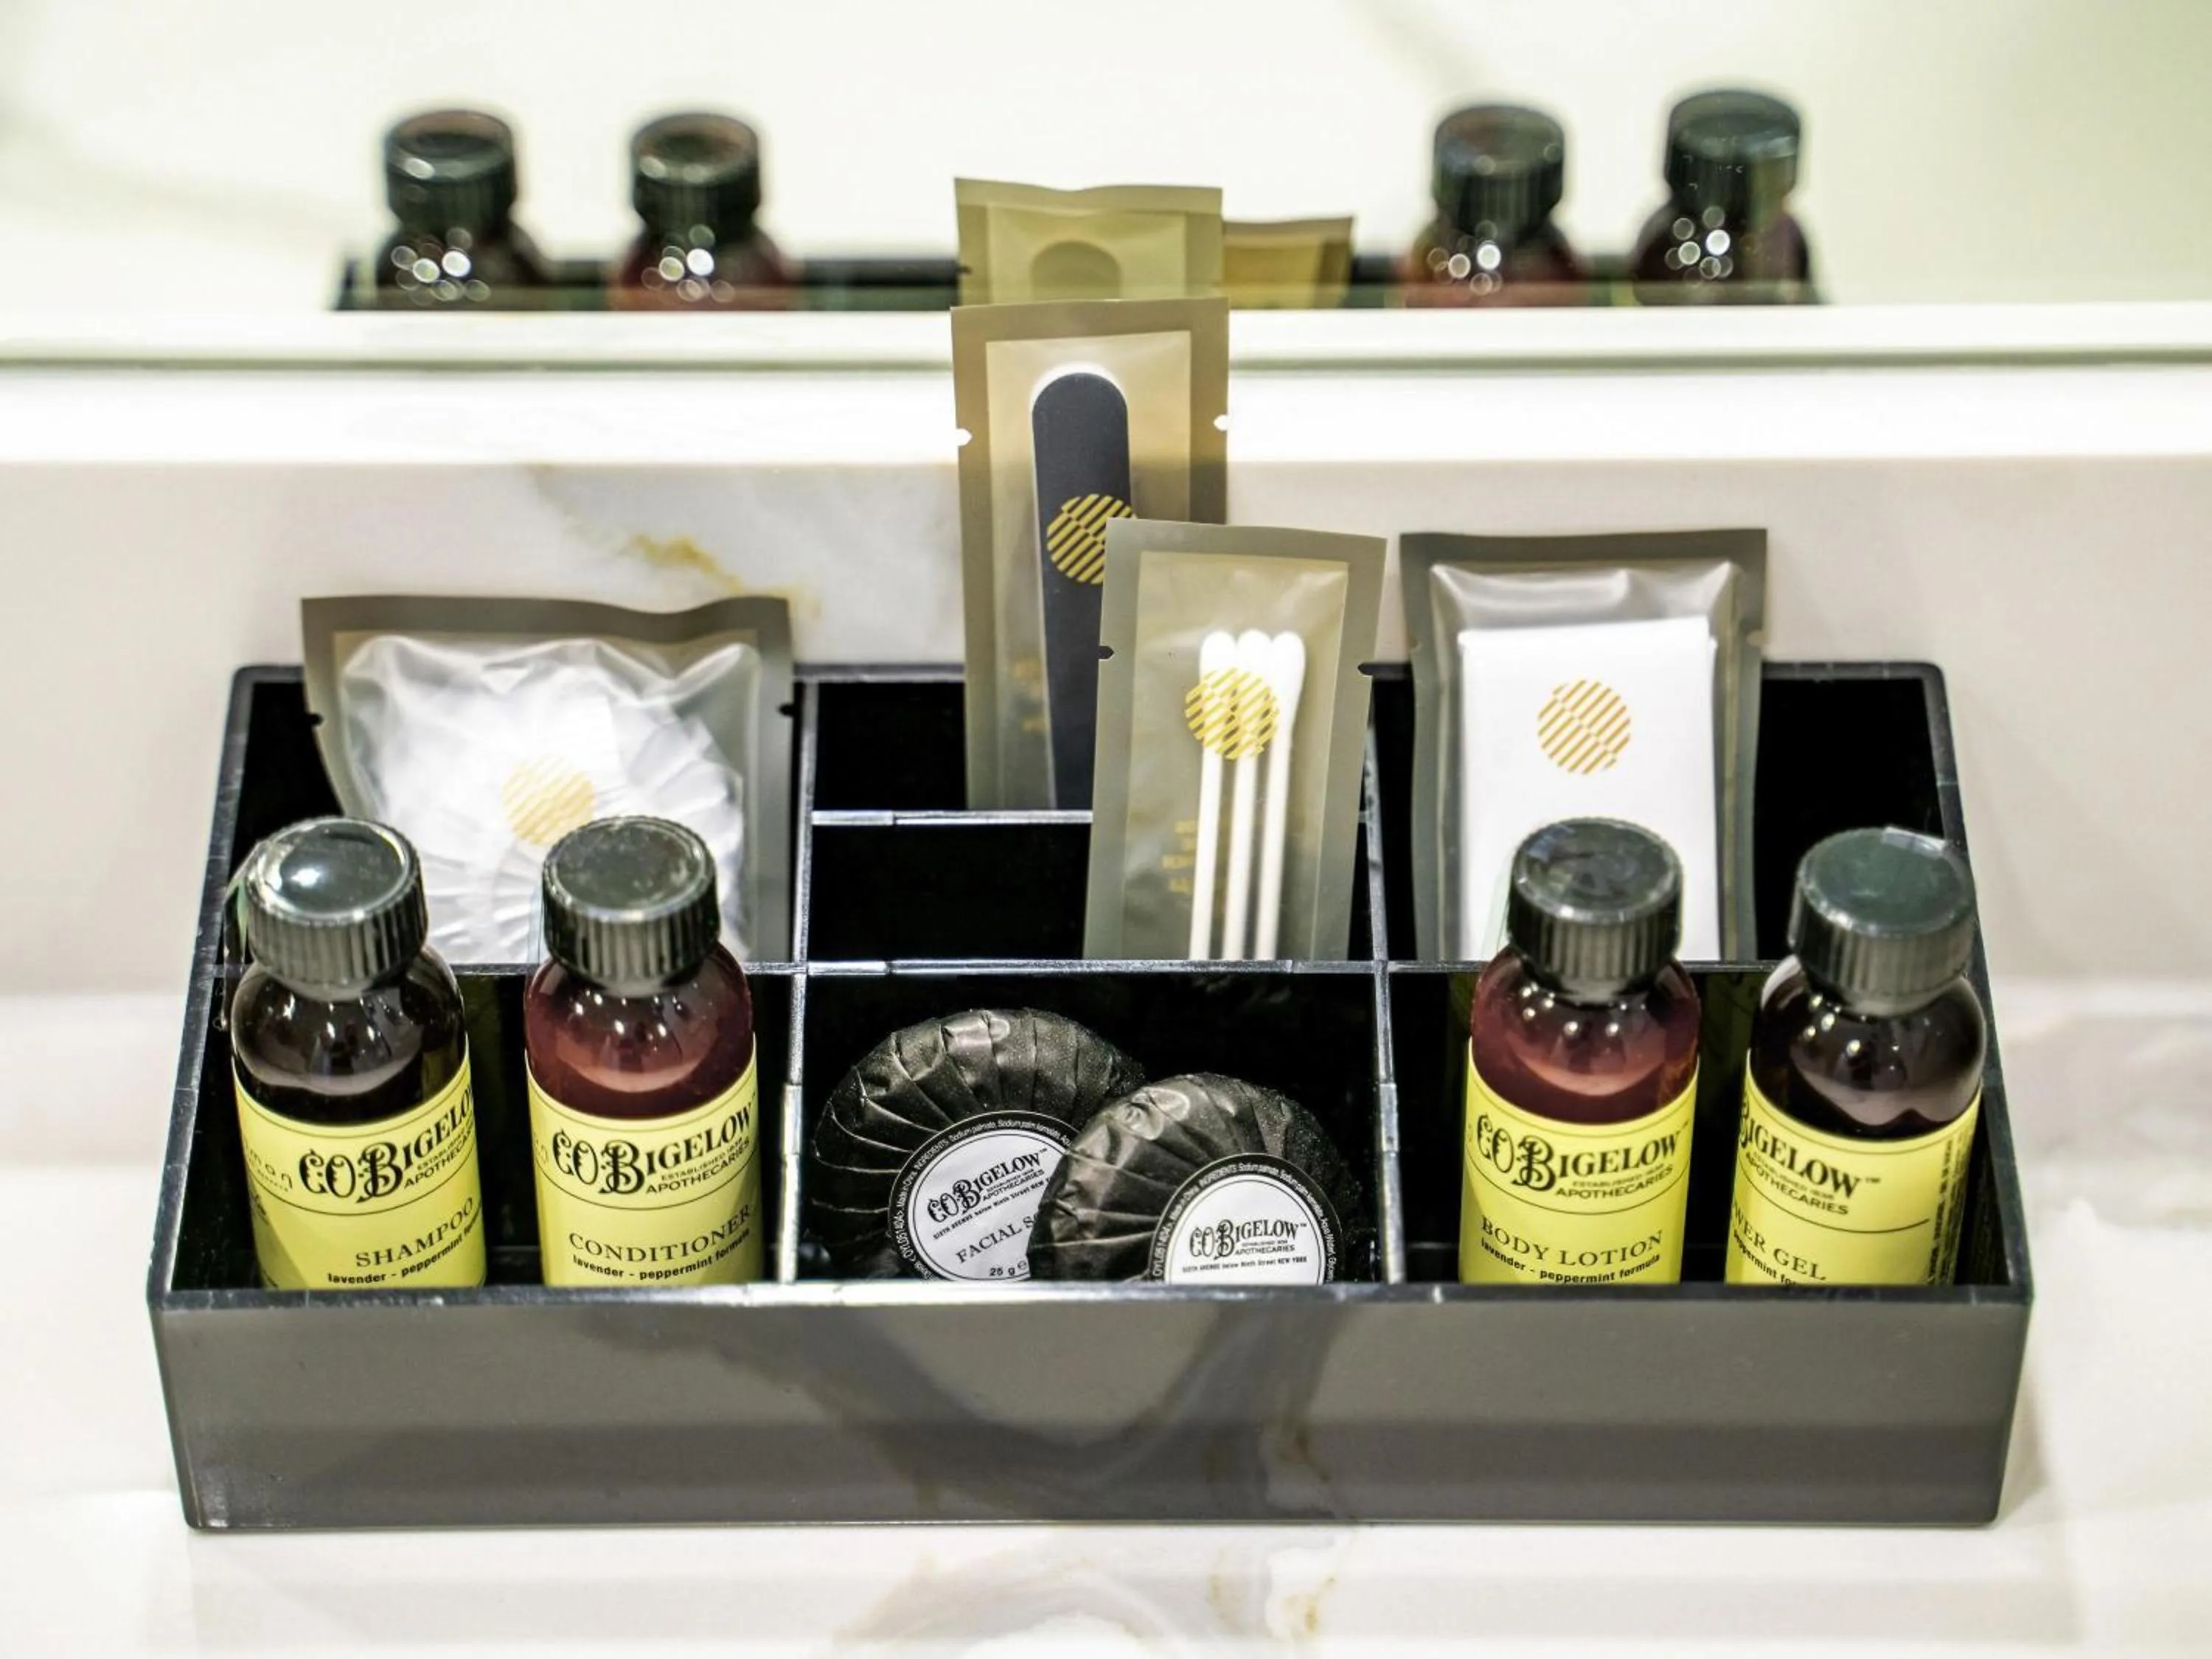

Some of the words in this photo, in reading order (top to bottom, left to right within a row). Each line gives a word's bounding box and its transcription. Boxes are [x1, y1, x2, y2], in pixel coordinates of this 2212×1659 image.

[983, 1169, 1045, 1201] APOTHECARIES
[1555, 1164, 1673, 1199] APOTHECARIES
[355, 1197, 473, 1268] SHAMPOO
[568, 1203, 751, 1262] CONDITIONER
[956, 1224, 1023, 1263] FACIAL
[1235, 1245, 1295, 1255] APOTHECARIES
[1482, 1215, 1549, 1260] BODY
[1559, 1230, 1663, 1266] LOTION
[328, 1272, 386, 1284] lavender
[401, 1233, 463, 1279] peppermint
[573, 1255, 624, 1278] lavender
[639, 1256, 712, 1280] peppermint
[1481, 1237, 1526, 1271] lavender
[1540, 1268, 1615, 1284] peppermint
[1620, 1253, 1660, 1278] formula
[1773, 1248, 1827, 1281] GEL
